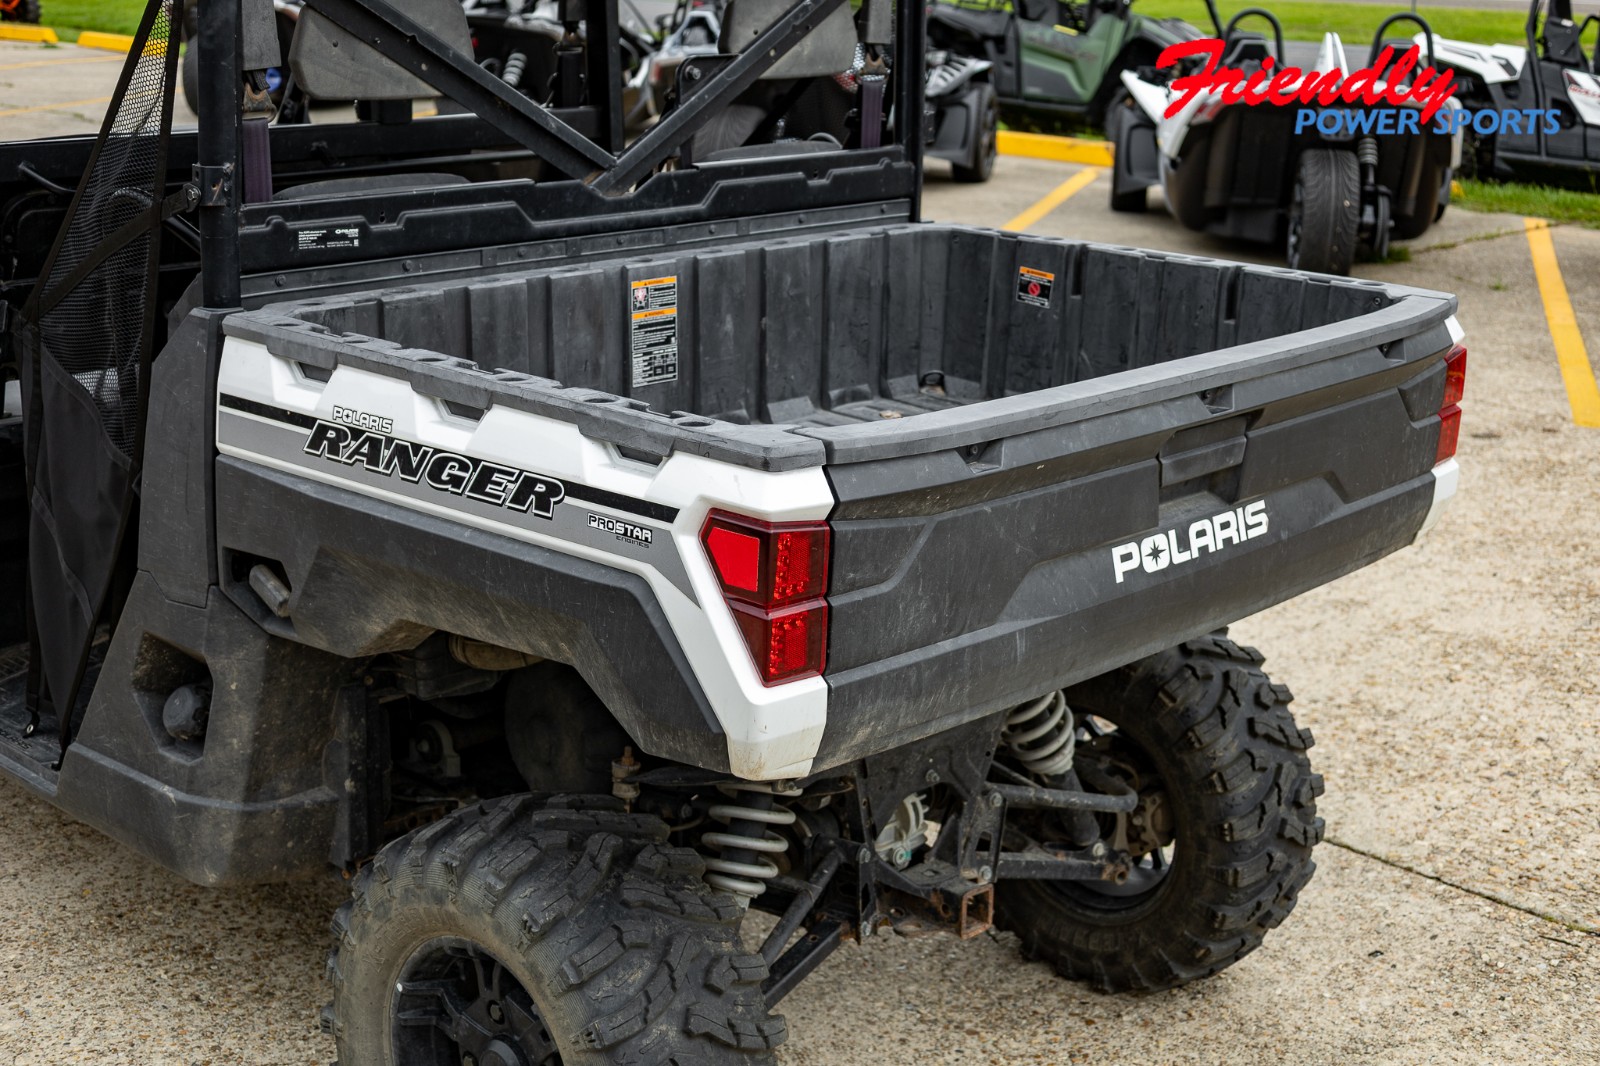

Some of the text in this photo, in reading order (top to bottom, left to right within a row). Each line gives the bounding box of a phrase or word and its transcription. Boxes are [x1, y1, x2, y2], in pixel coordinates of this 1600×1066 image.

[332, 405, 393, 434] POLARIS
[302, 419, 565, 521] RANGER
[587, 512, 653, 544] PROSTAR
[615, 535, 650, 549] ENGINES
[1111, 499, 1269, 584] POLARIS
